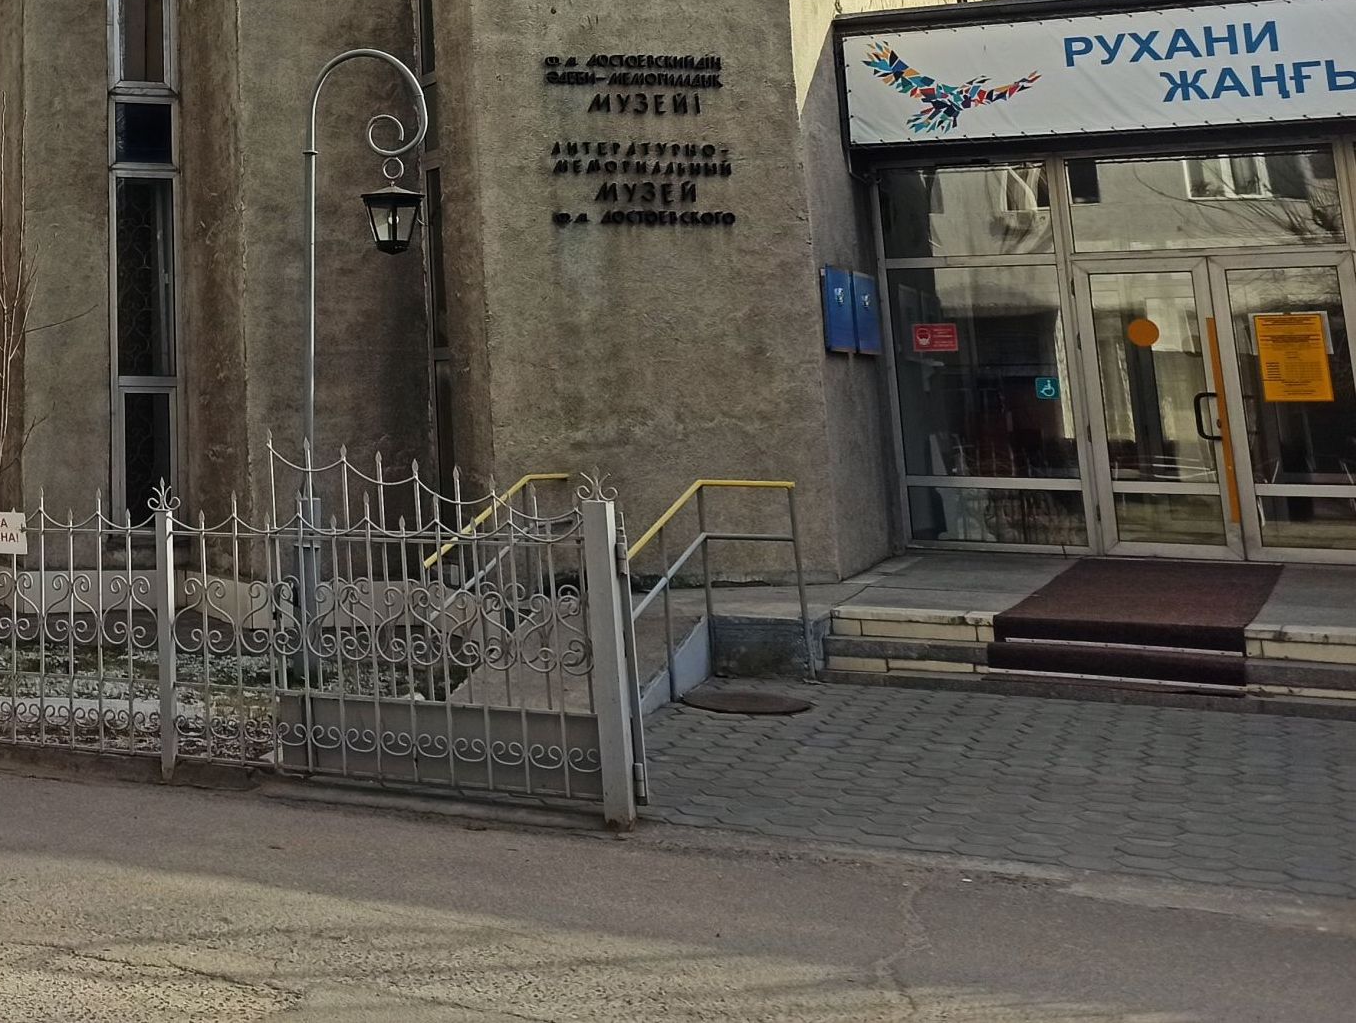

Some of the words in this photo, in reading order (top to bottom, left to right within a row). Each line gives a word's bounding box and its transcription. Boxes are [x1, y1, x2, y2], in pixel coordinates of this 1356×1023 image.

[1064, 21, 1280, 67] РУХАНИ
[587, 92, 701, 115] МУЗЕЙІ
[553, 159, 732, 177] МЕМОРИАЛЬНЫЙ
[595, 181, 697, 205] МУЗЕЙ
